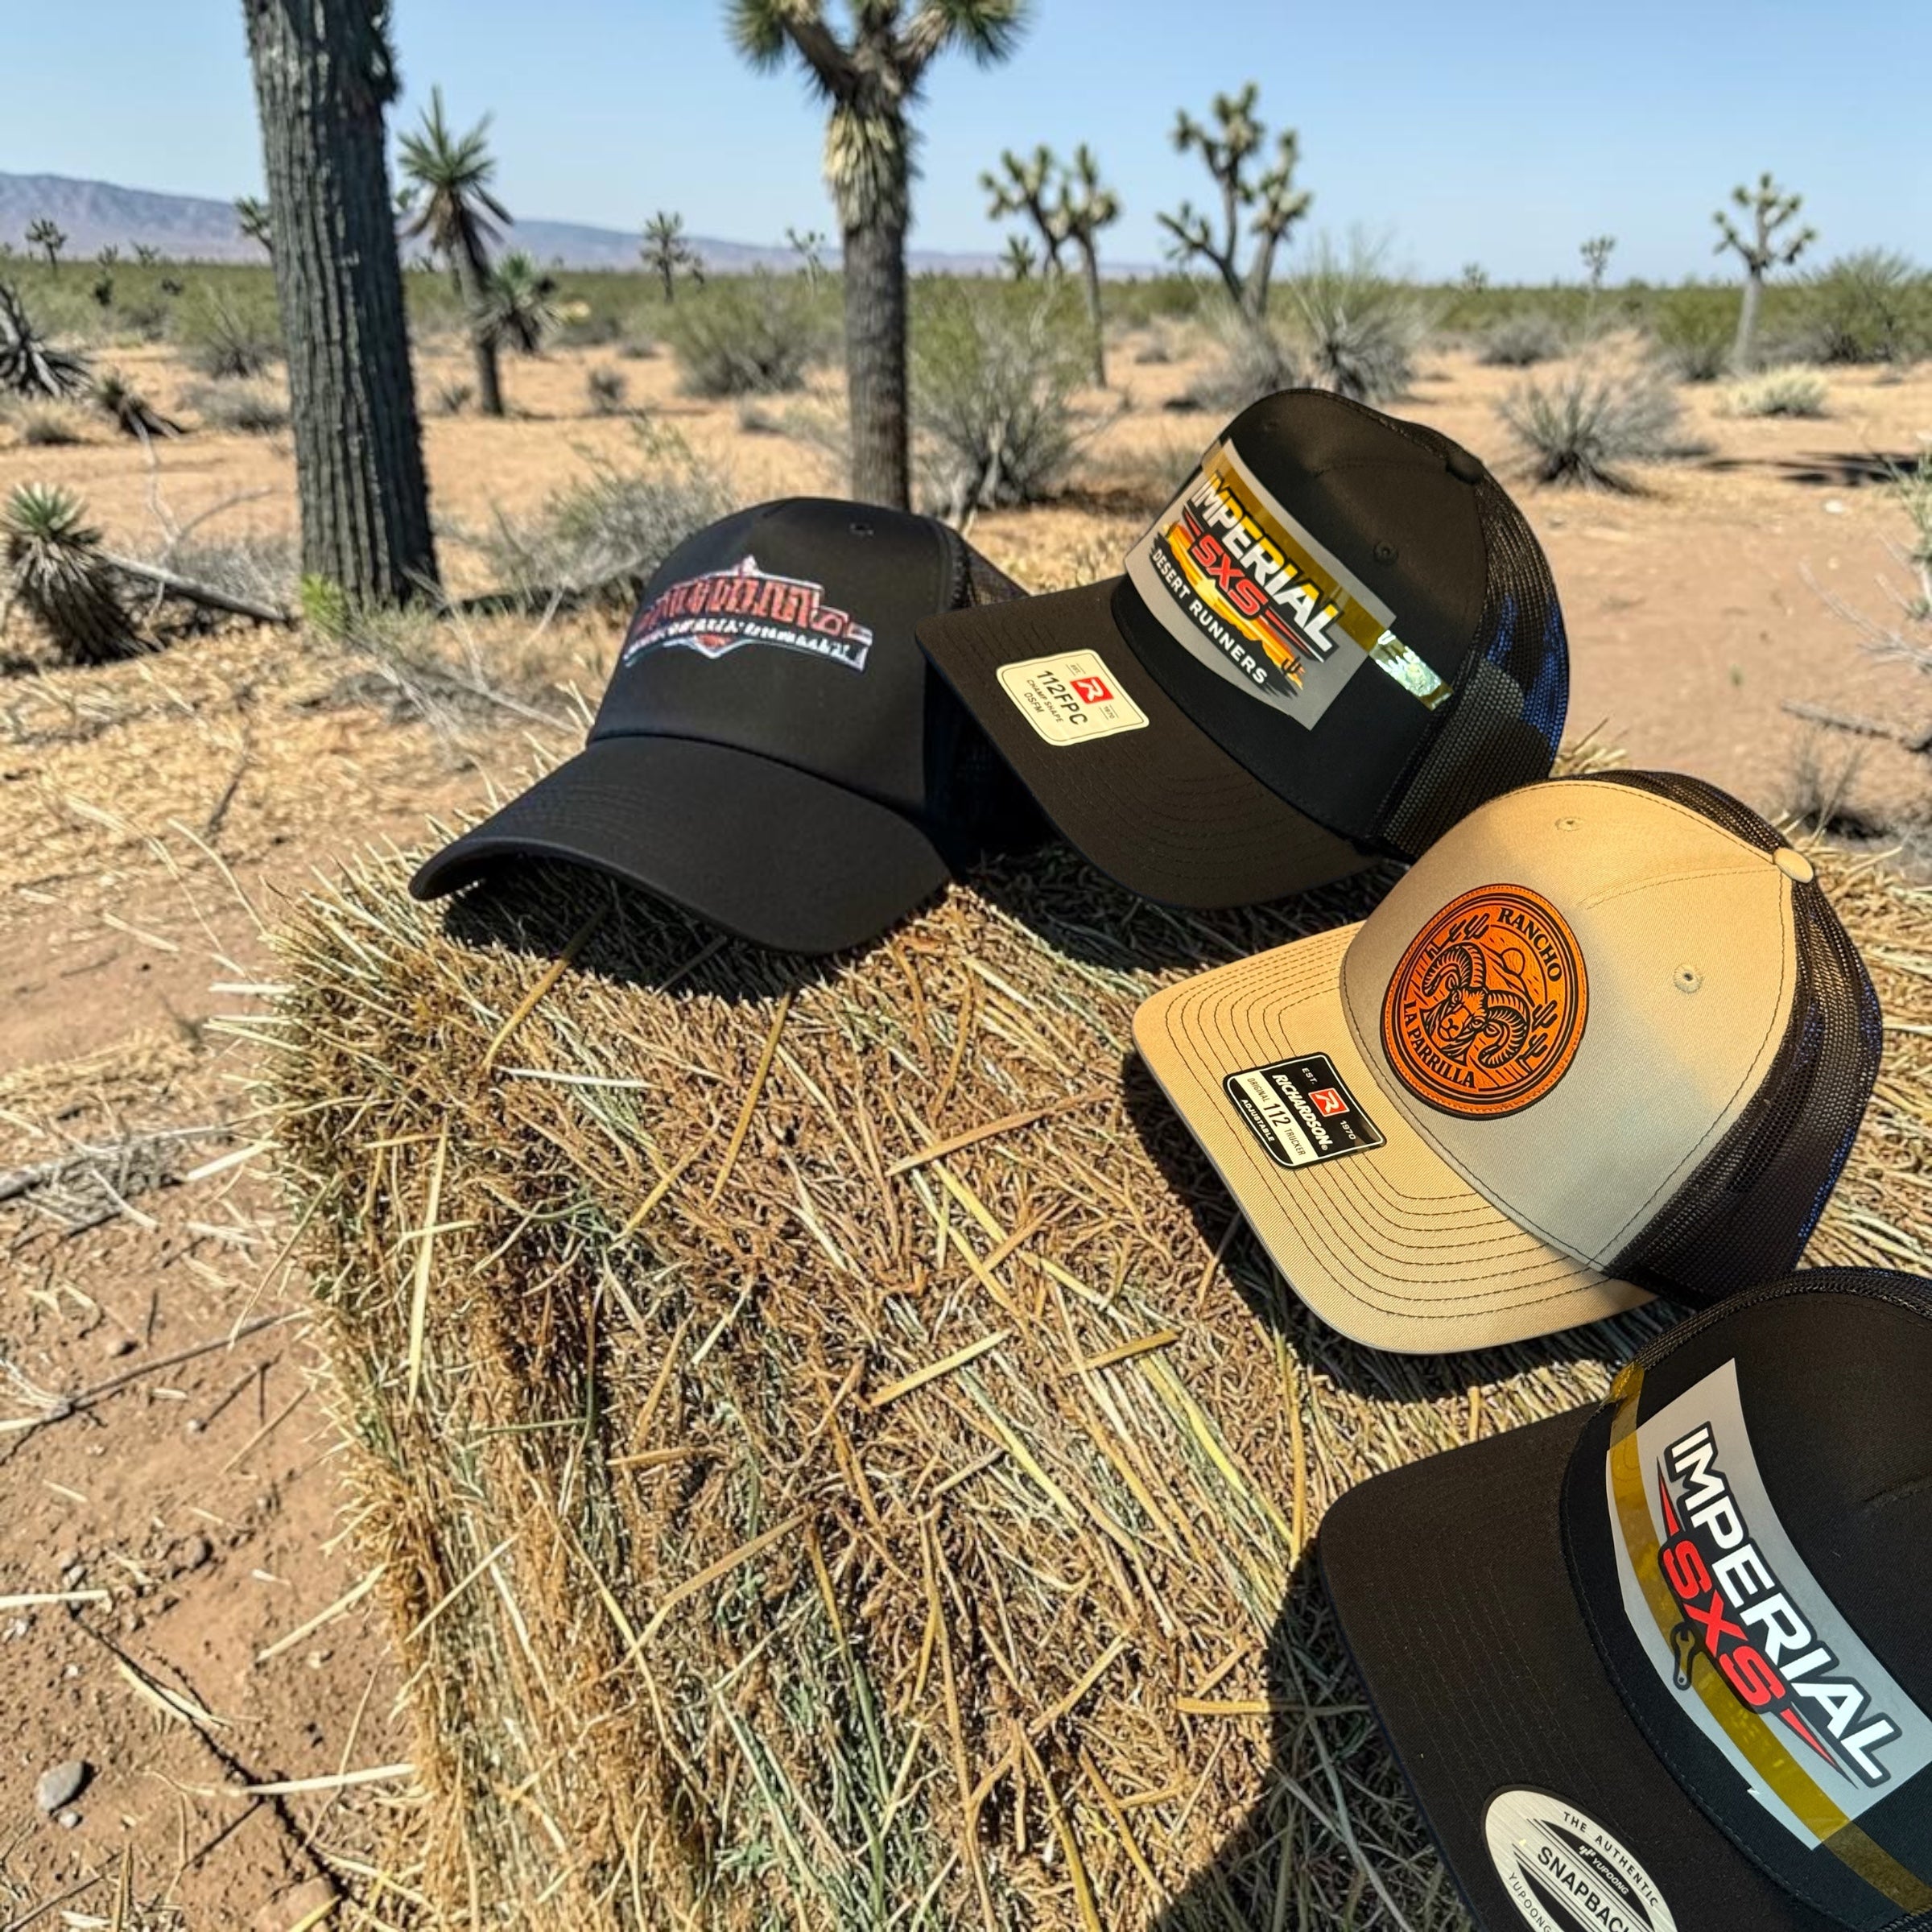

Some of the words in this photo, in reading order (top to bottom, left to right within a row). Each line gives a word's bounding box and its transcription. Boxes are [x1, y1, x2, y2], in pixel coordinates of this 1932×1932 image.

[1189, 471, 1340, 653] IMPERIAL
[1190, 533, 1269, 617] SXS
[1152, 547, 1191, 599] DESERT
[1189, 598, 1268, 684] RUNNERS
[1037, 671, 1088, 725] 112FPC
[1496, 907, 1563, 982] RANCHO
[1403, 999, 1418, 1025] LA
[1301, 1067, 1318, 1085] EST.
[1406, 1026, 1476, 1089] PARRILLA
[1241, 1098, 1275, 1143] ADJUSTABLE
[1246, 1077, 1271, 1103] ORIGINAL
[1263, 1103, 1292, 1127] 112
[1283, 1128, 1307, 1156] TRUCKER
[1340, 1120, 1357, 1141] 1970
[1662, 1539, 1787, 1707] SXS
[1670, 1426, 1897, 1781] IMPERIAL
[1537, 1846, 1630, 1932] SNAPBAC
[1563, 1811, 1587, 1833] THE
[1594, 1835, 1659, 1908] AUTHENTIC
[1592, 1857, 1629, 1895] YUPOONG
[1508, 1872, 1552, 1932] YUPOONG
